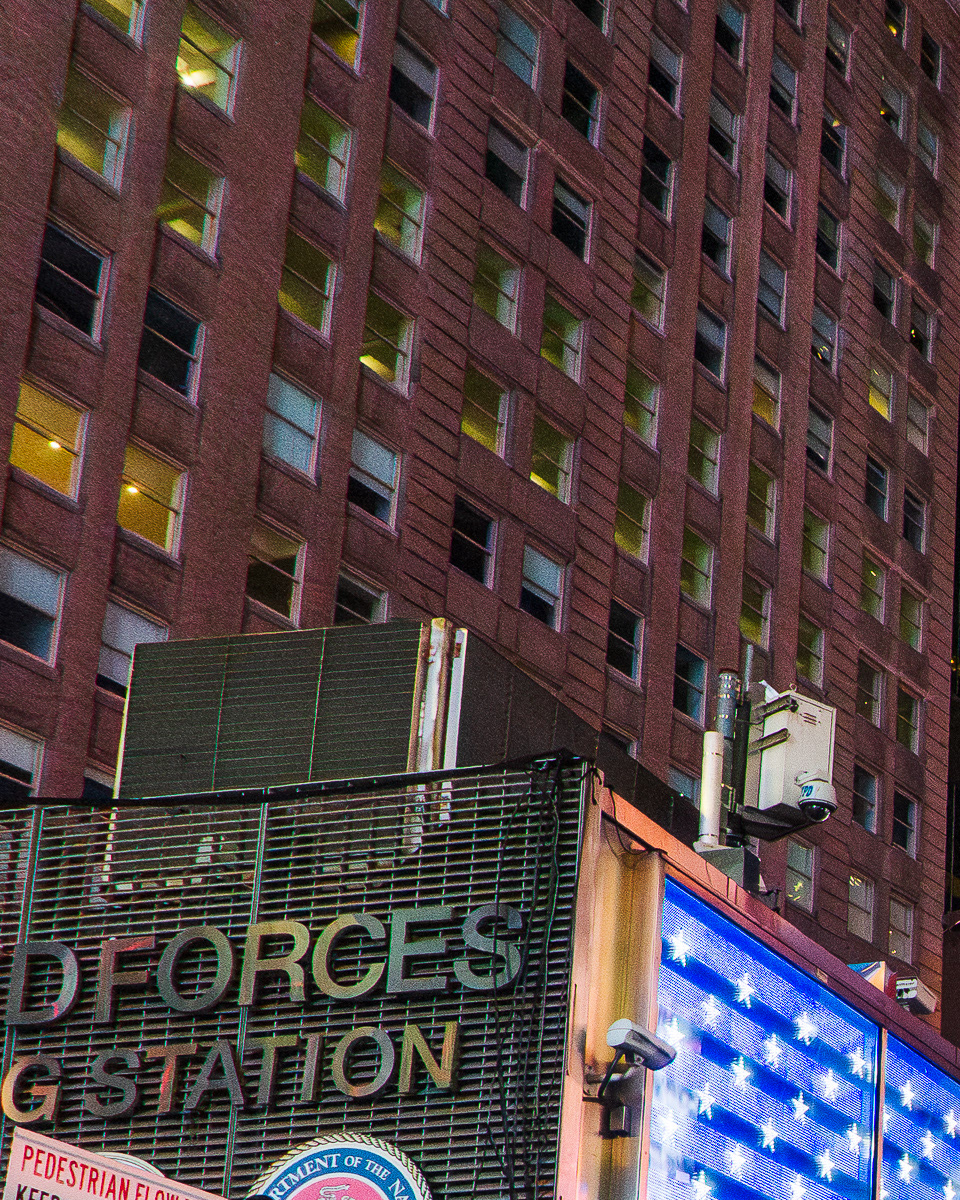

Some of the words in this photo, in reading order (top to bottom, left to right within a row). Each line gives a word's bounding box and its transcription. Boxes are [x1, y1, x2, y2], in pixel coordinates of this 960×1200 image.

[99, 903, 524, 1023] FORCES
[80, 1021, 459, 1119] STATION
[344, 1155, 361, 1168] OF
[364, 1159, 390, 1180] THE
